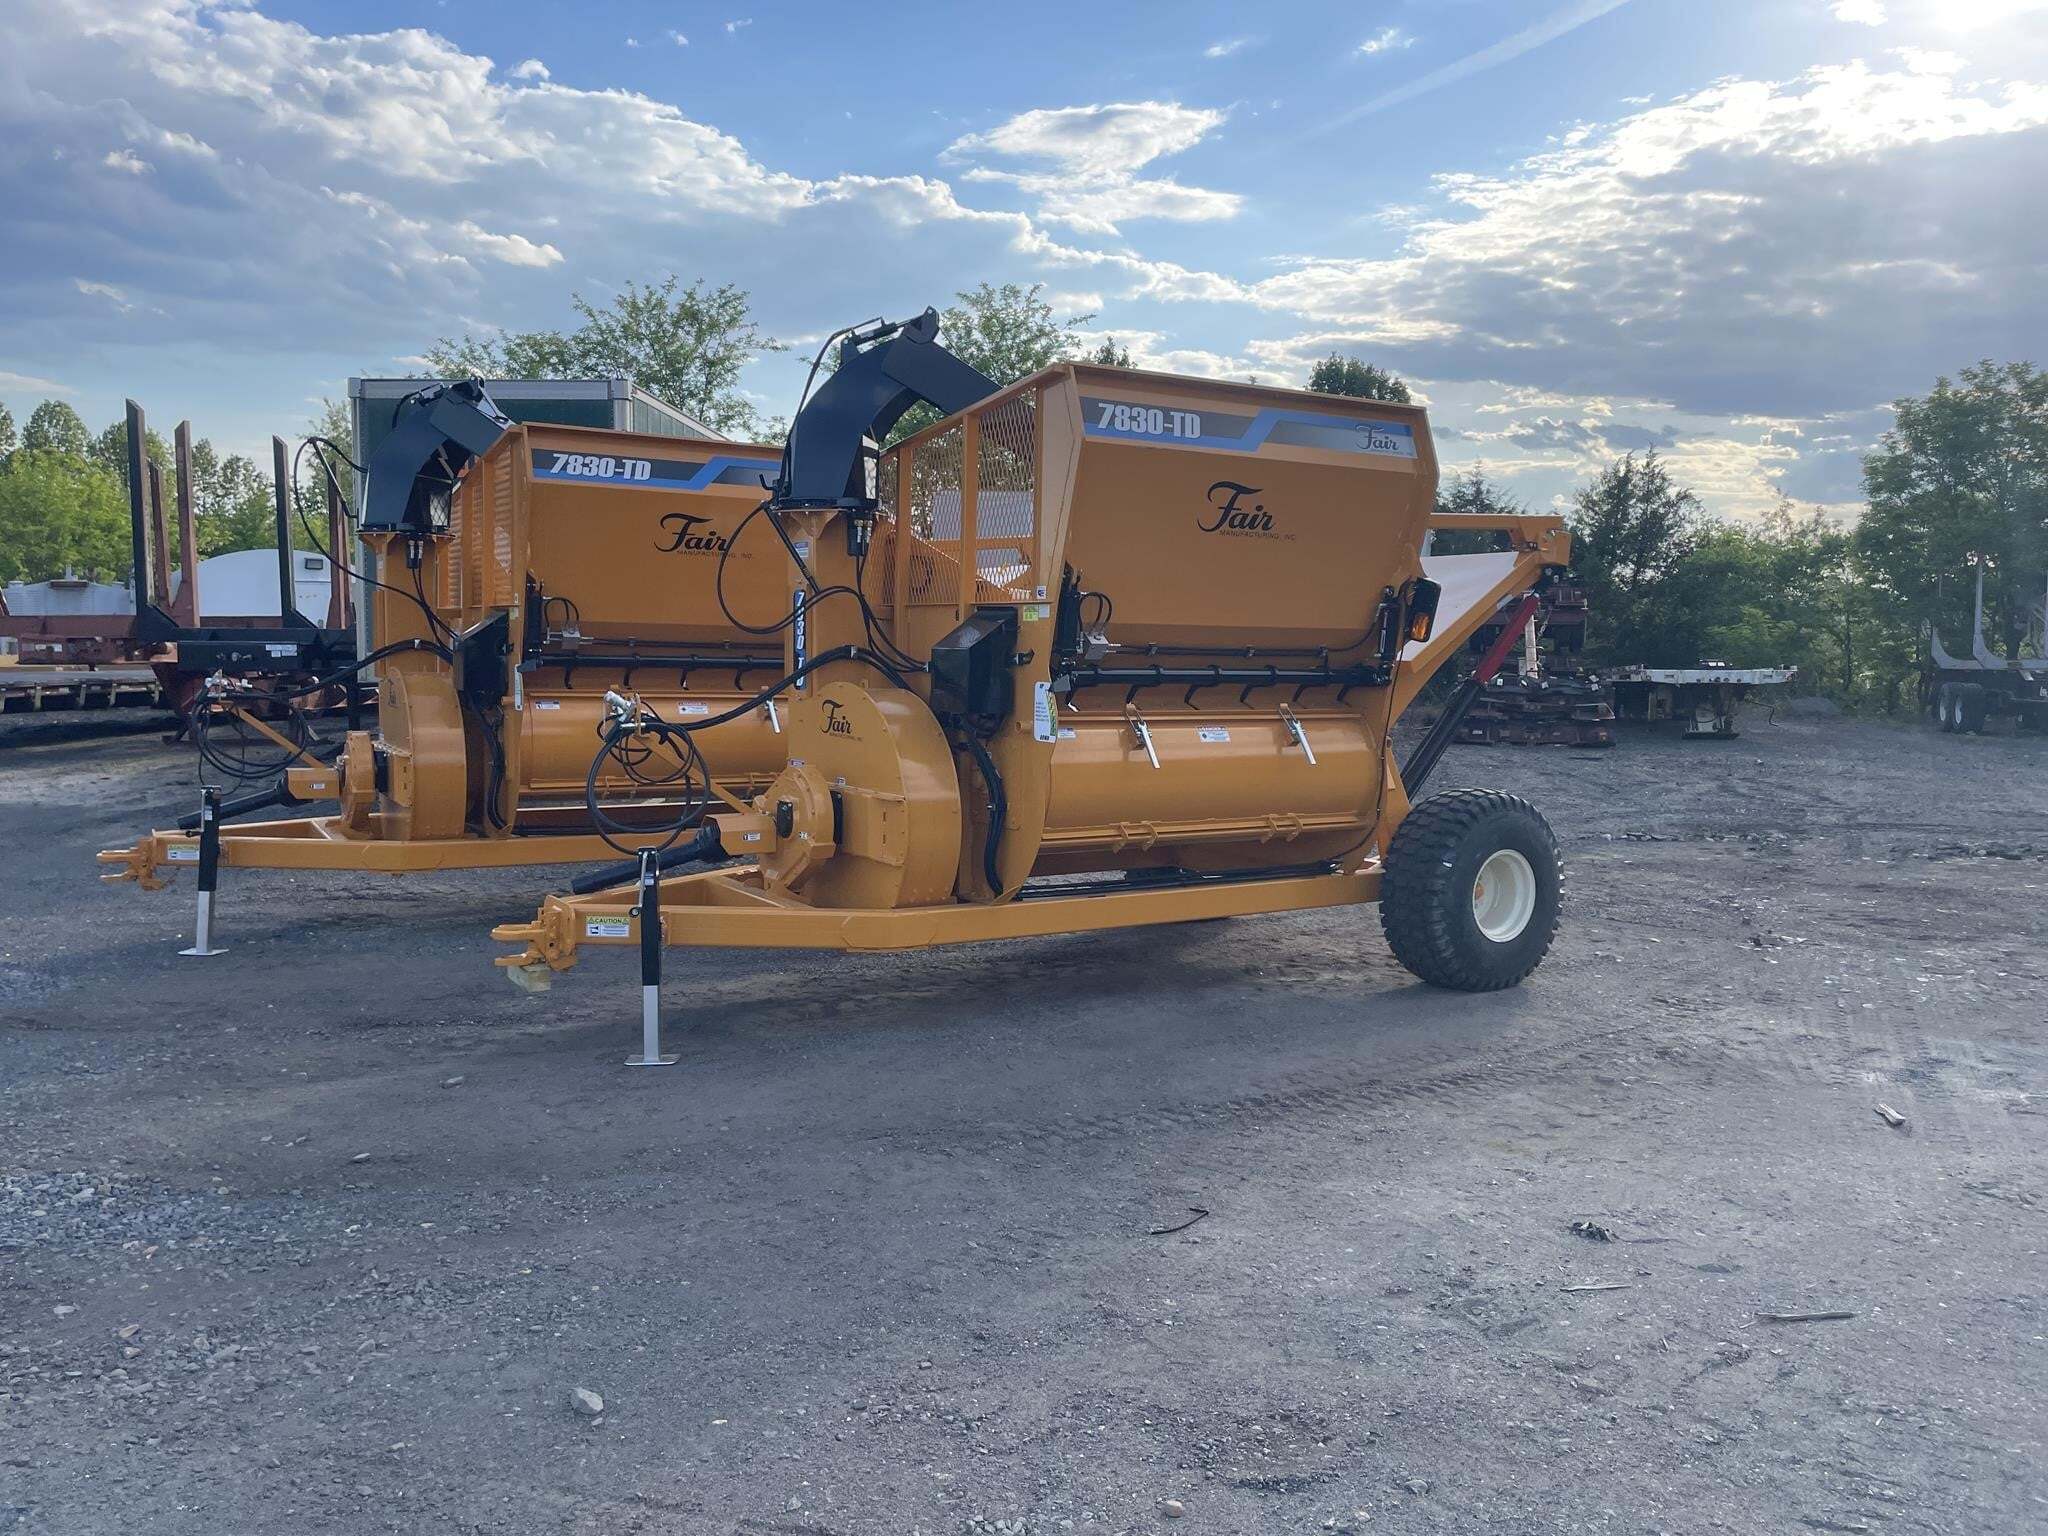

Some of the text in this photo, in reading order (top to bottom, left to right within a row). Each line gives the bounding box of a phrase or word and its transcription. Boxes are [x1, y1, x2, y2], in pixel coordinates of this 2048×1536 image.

[1097, 402, 1201, 439] 7830-TD
[1354, 423, 1399, 451] Fair
[550, 453, 652, 481] 7830-TD
[1197, 480, 1275, 532] Fair
[653, 512, 728, 552] Fair
[820, 699, 851, 734] Fair
